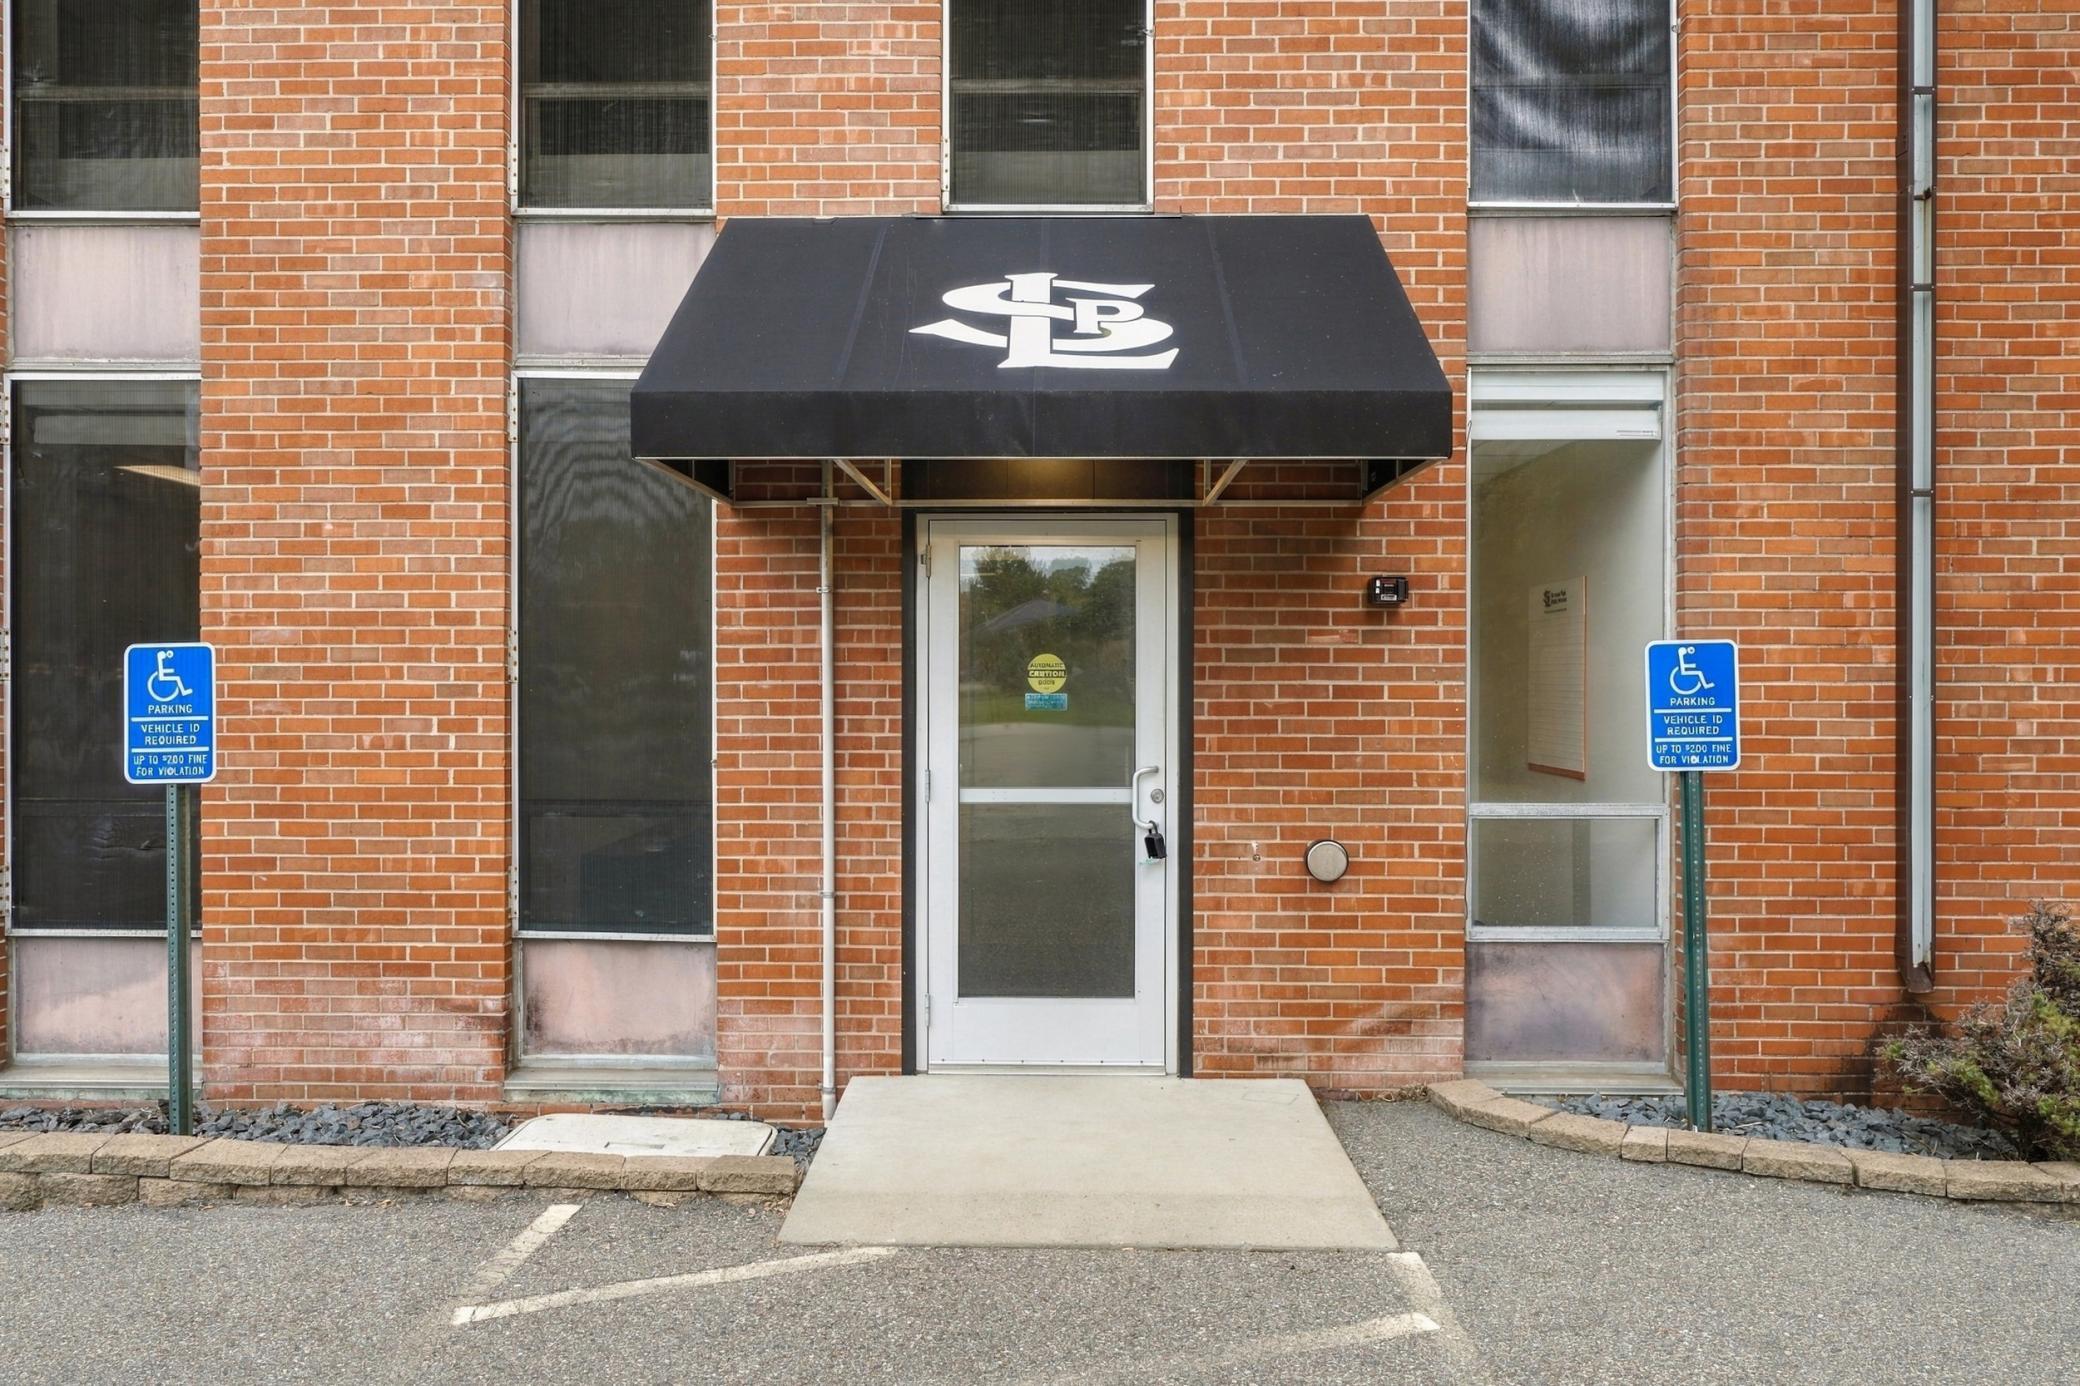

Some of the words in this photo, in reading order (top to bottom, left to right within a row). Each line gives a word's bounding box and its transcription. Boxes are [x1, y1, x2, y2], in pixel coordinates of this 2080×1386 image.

[1670, 697, 1716, 706] PARKING
[148, 704, 193, 714] PARKING
[1663, 715, 1708, 724] VEHICLE
[1712, 714, 1723, 724] ID
[141, 723, 184, 734] VEHICLE
[189, 723, 200, 733] ID
[1667, 726, 1720, 736] REQUIRED
[144, 735, 197, 746] REQUIRED
[1656, 744, 1668, 754] UP
[1671, 744, 1682, 753] TO
[1685, 744, 1708, 753] $200
[1712, 743, 1732, 753] FINE
[133, 755, 145, 765] UP
[148, 755, 159, 764] TO
[162, 754, 184, 764] $200
[188, 753, 207, 764] FINE
[1660, 755, 1677, 764] FOR
[1681, 754, 1729, 764] VIOLATION
[136, 766, 153, 776] FOR
[158, 765, 205, 776] VIOLATION
